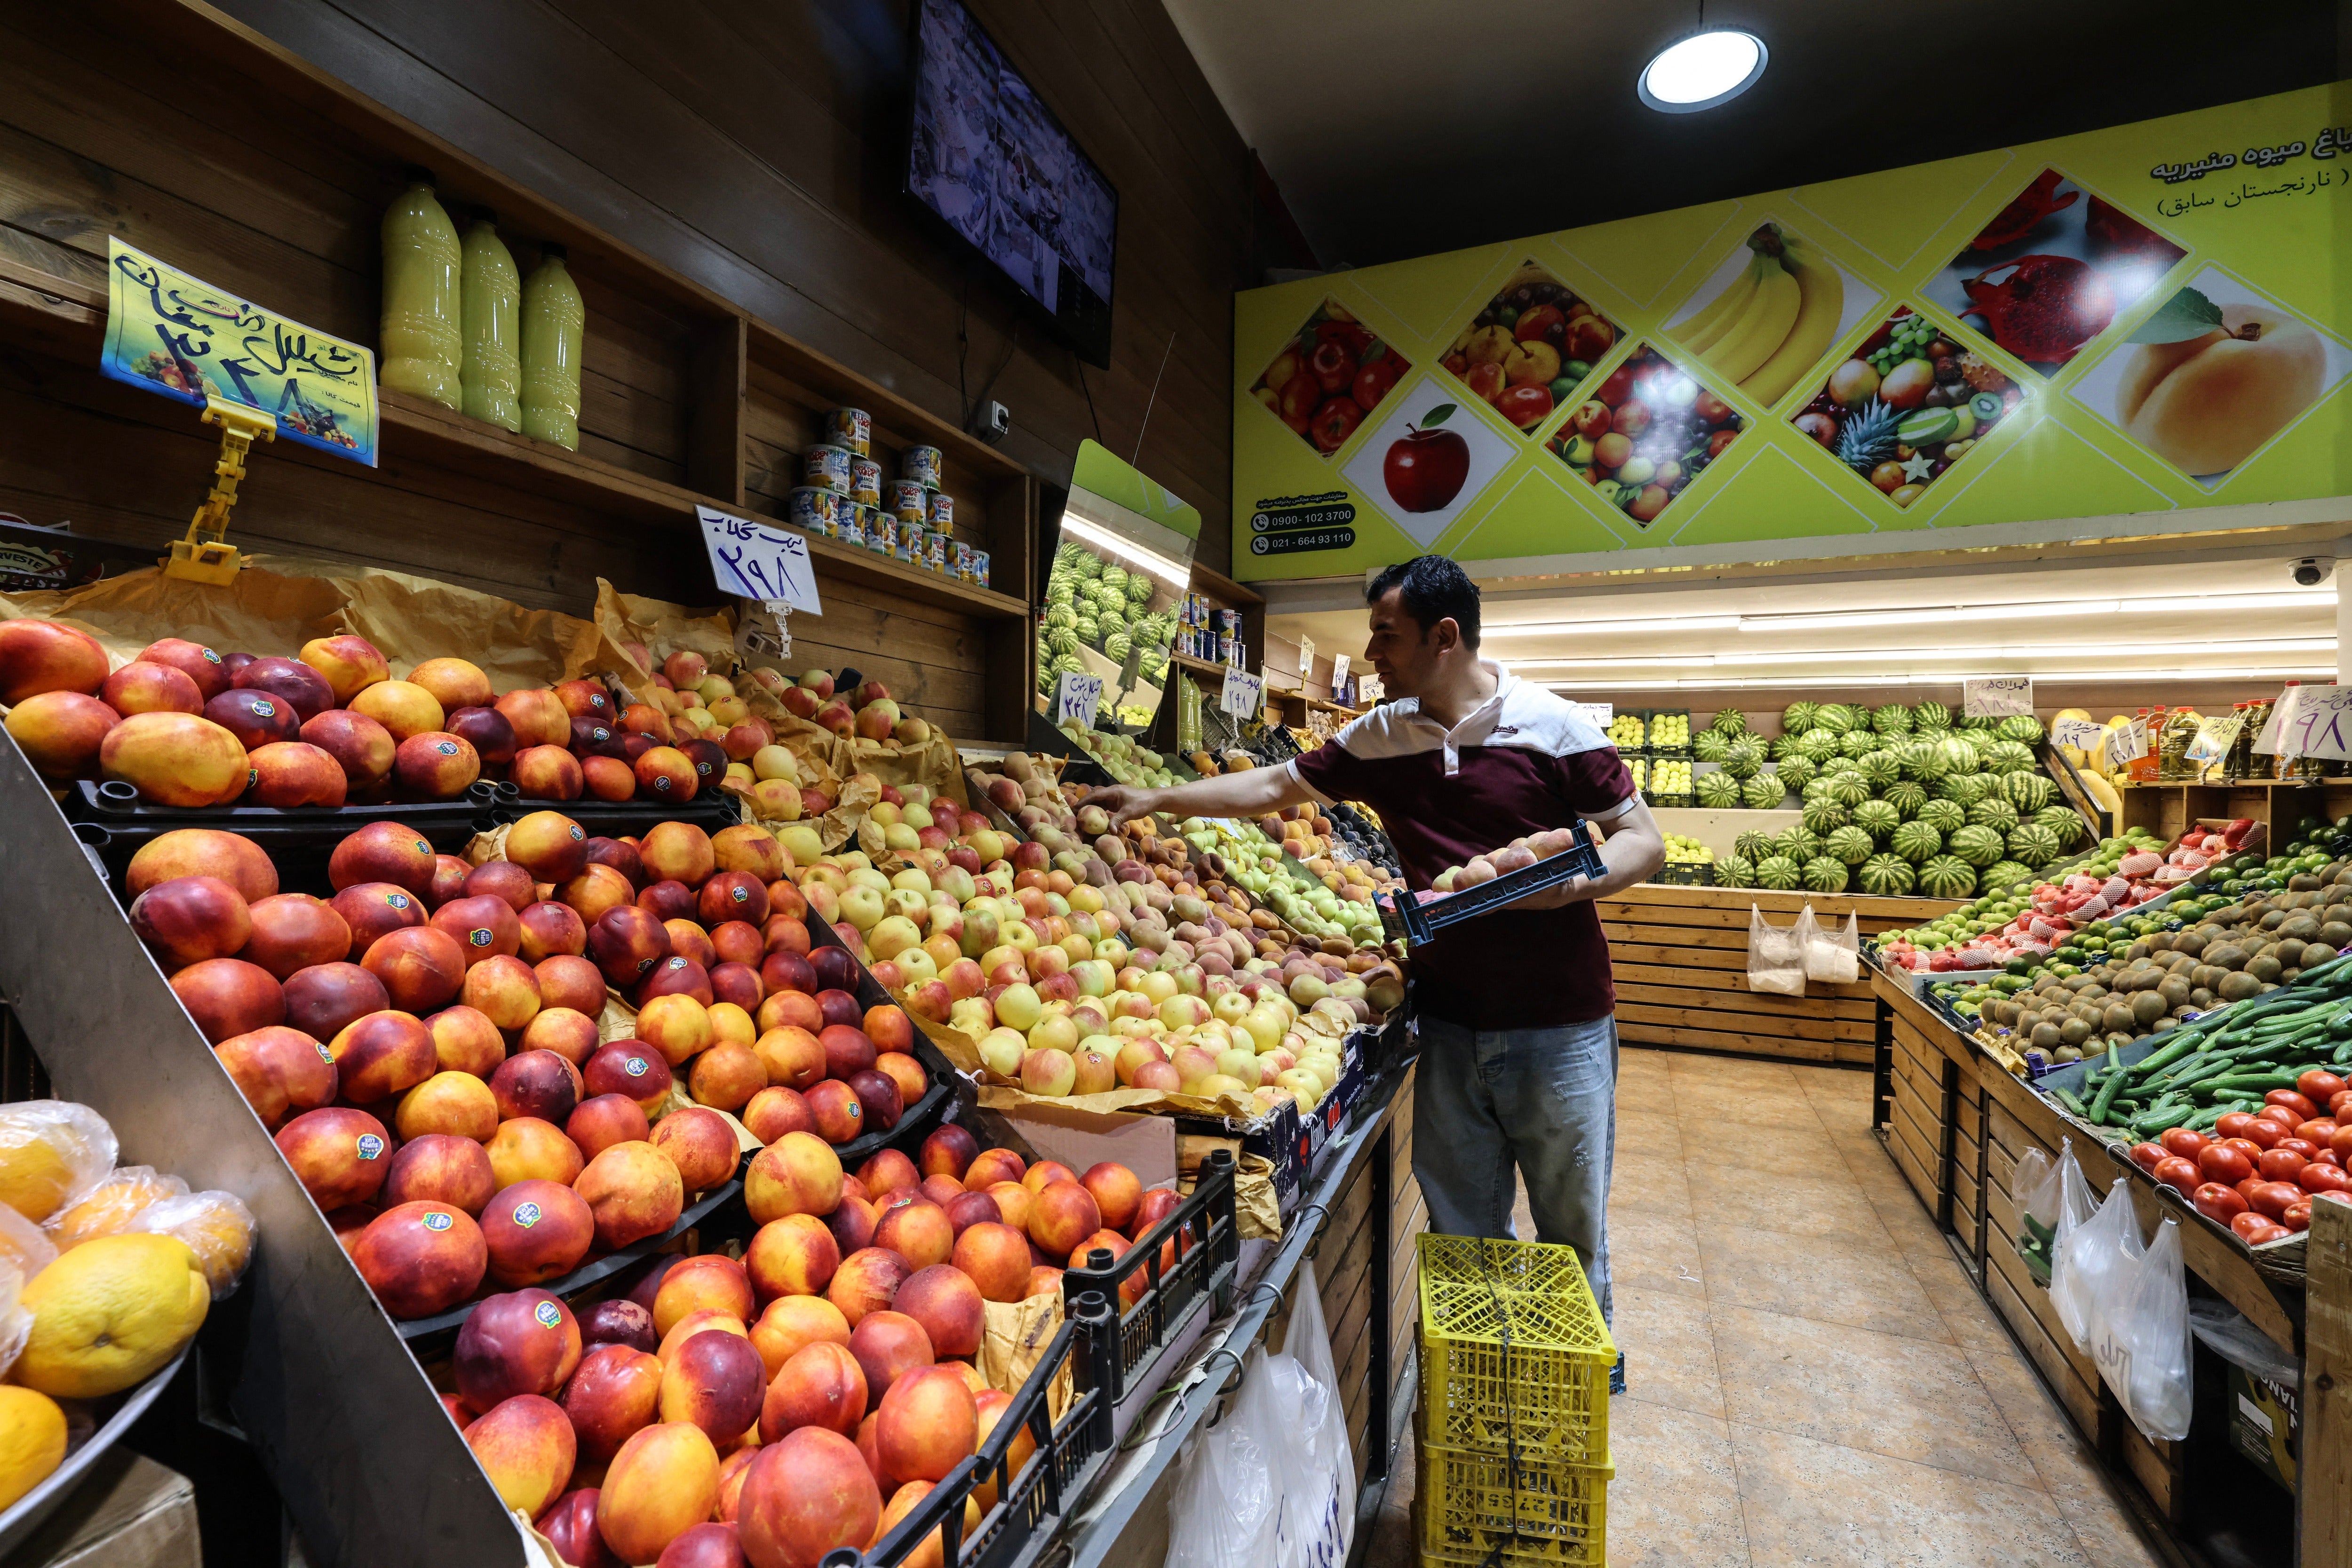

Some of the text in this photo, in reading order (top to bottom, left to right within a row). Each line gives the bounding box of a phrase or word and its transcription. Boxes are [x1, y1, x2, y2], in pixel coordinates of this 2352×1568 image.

[2243, 141, 2305, 167] میوه
[2151, 152, 2236, 183] منیریه
[2224, 170, 2331, 208] نارنجستان
[339, 398, 361, 408] قیمت
[898, 486, 921, 494] GOLDEN
[1305, 513, 1323, 523] 102
[1326, 510, 1351, 521] 3700
[702, 517, 804, 557] سیب گلاب
[1272, 539, 1289, 548] 021
[1298, 536, 1316, 545] 664
[1318, 535, 1330, 544] 93
[1333, 533, 1351, 542] 110
[717, 545, 802, 601] ۲۹۸
